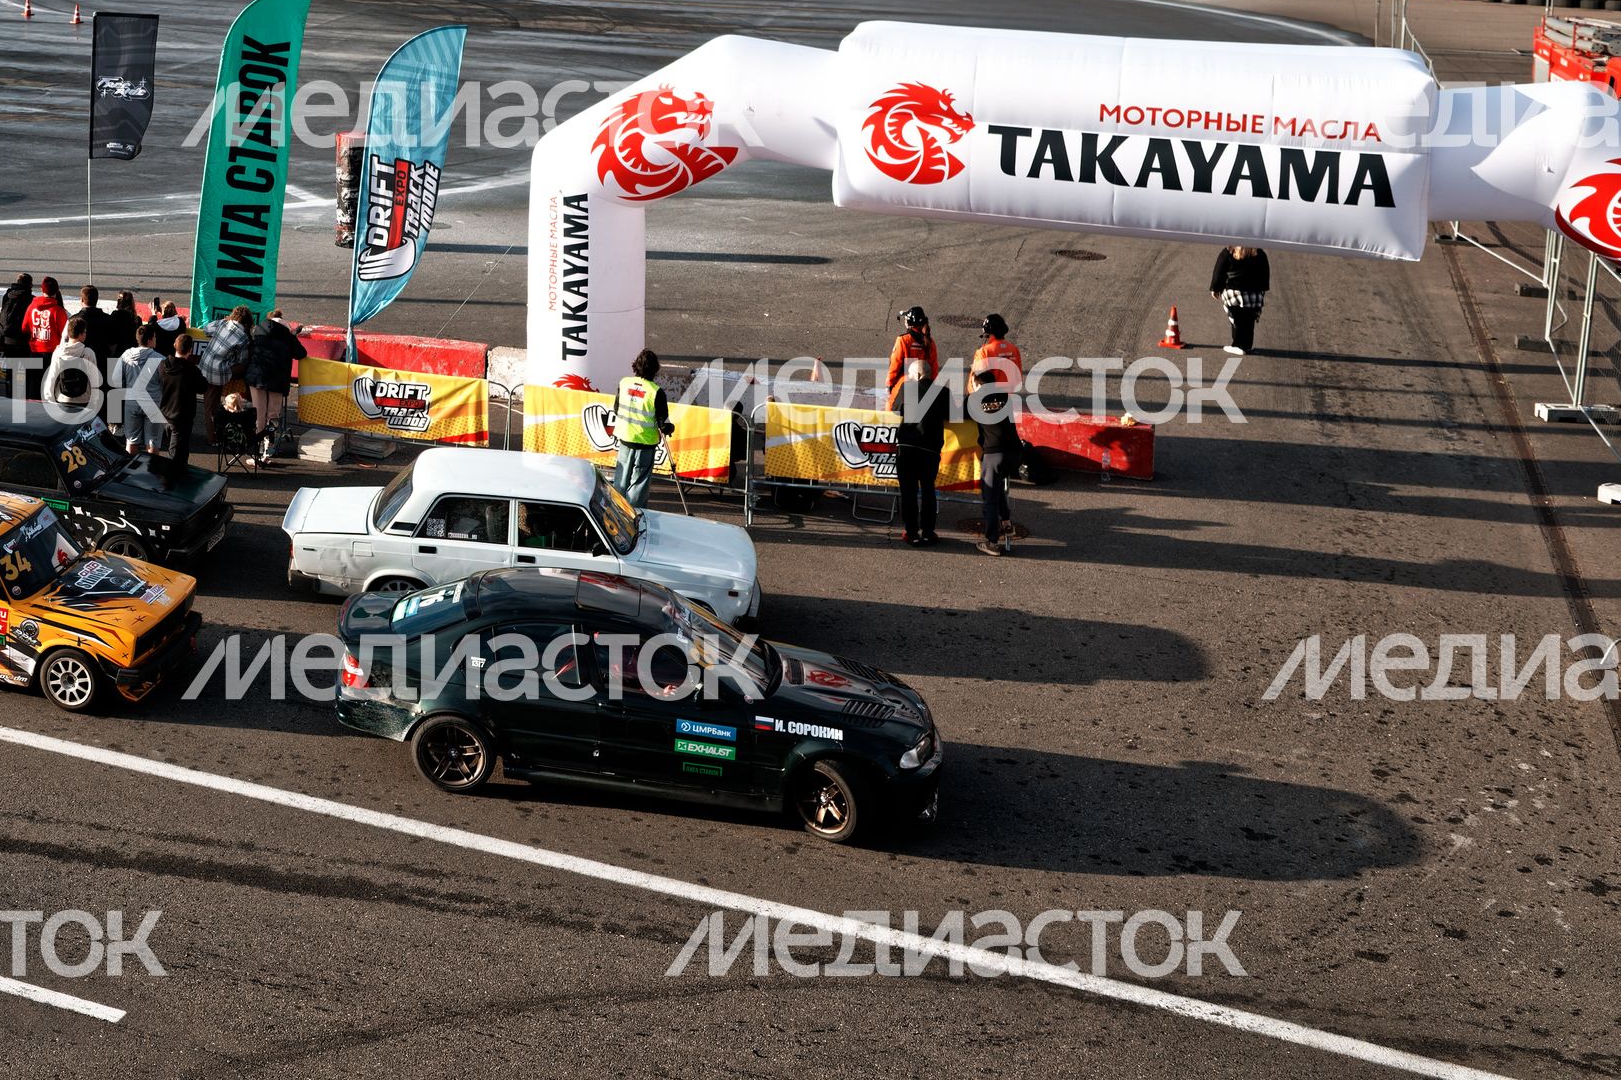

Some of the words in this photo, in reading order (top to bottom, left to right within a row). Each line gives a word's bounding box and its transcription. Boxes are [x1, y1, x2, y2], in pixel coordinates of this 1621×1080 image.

[226, 35, 292, 194] СТАВОК
[1099, 103, 1265, 135] МОТОРНЫЕ
[1273, 115, 1383, 142] МАСЛА
[988, 124, 1397, 208] TAKAYAMA
[367, 156, 395, 247] DRIFT
[395, 169, 408, 208] EXPO
[406, 164, 426, 238] TRACK
[420, 161, 441, 232] MODE
[549, 196, 558, 240] МАСЛА
[214, 204, 271, 303] ЛИГА
[548, 242, 558, 312] МОТОРНЫЕ
[562, 193, 589, 361] TAKAYAMA
[375, 383, 427, 400] DRIFT
[384, 407, 426, 418] TRACK
[390, 417, 427, 428] MODE
[861, 426, 899, 444] DRI
[61, 446, 88, 473] 28
[0, 550, 32, 581] 34
[692, 724, 732, 738] ЦМРБанк
[775, 719, 786, 733] И.
[788, 721, 844, 741] СОРОКИН
[688, 743, 733, 757] EXHAUST
